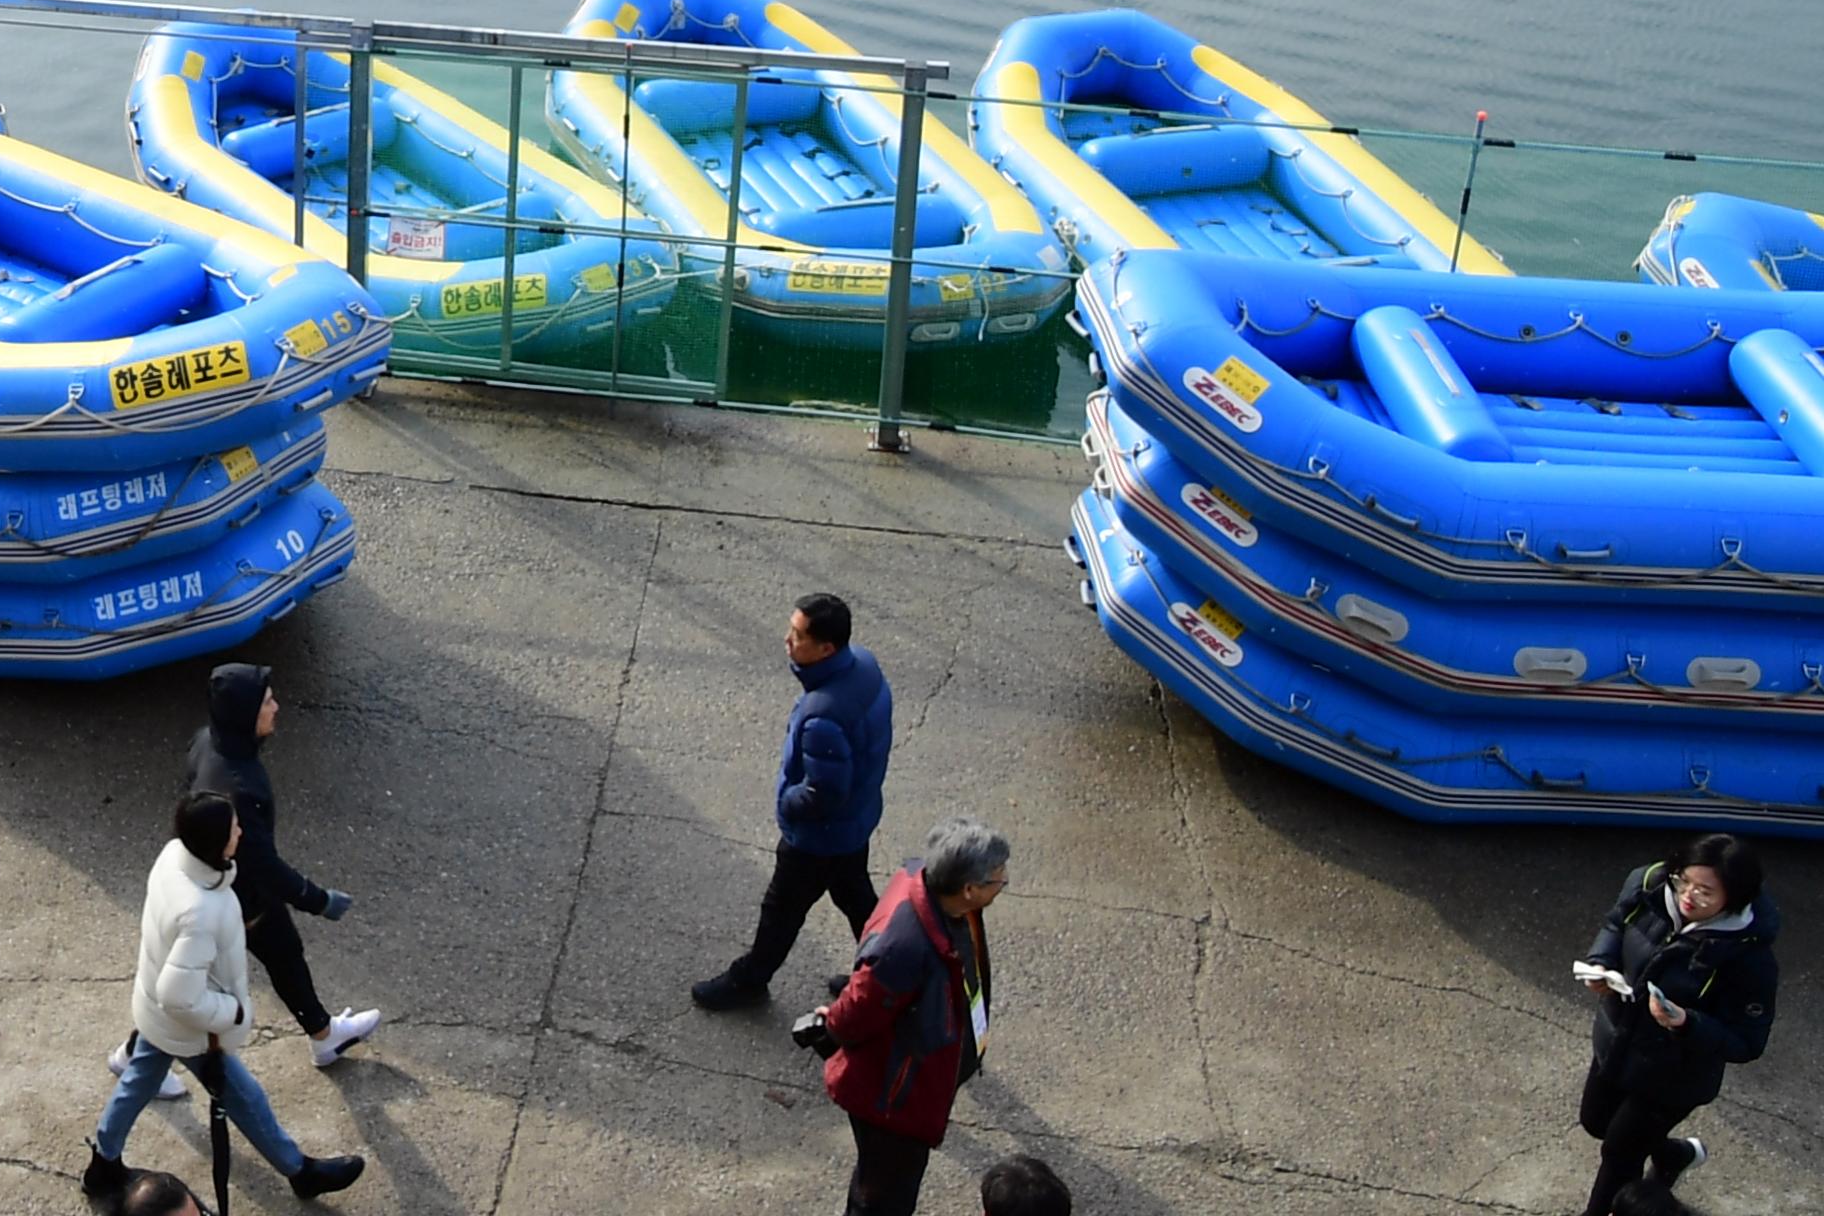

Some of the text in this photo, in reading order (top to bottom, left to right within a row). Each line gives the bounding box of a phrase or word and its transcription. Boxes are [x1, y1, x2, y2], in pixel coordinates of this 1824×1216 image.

[392, 231, 442, 248] 출입금지!
[321, 311, 352, 340] 15
[114, 346, 244, 404] 한솔레포츠
[1192, 375, 1254, 425] ZEBEC
[1189, 490, 1251, 540] ZEBEC
[275, 529, 305, 561] 10
[1177, 610, 1238, 659] ZEBEC
